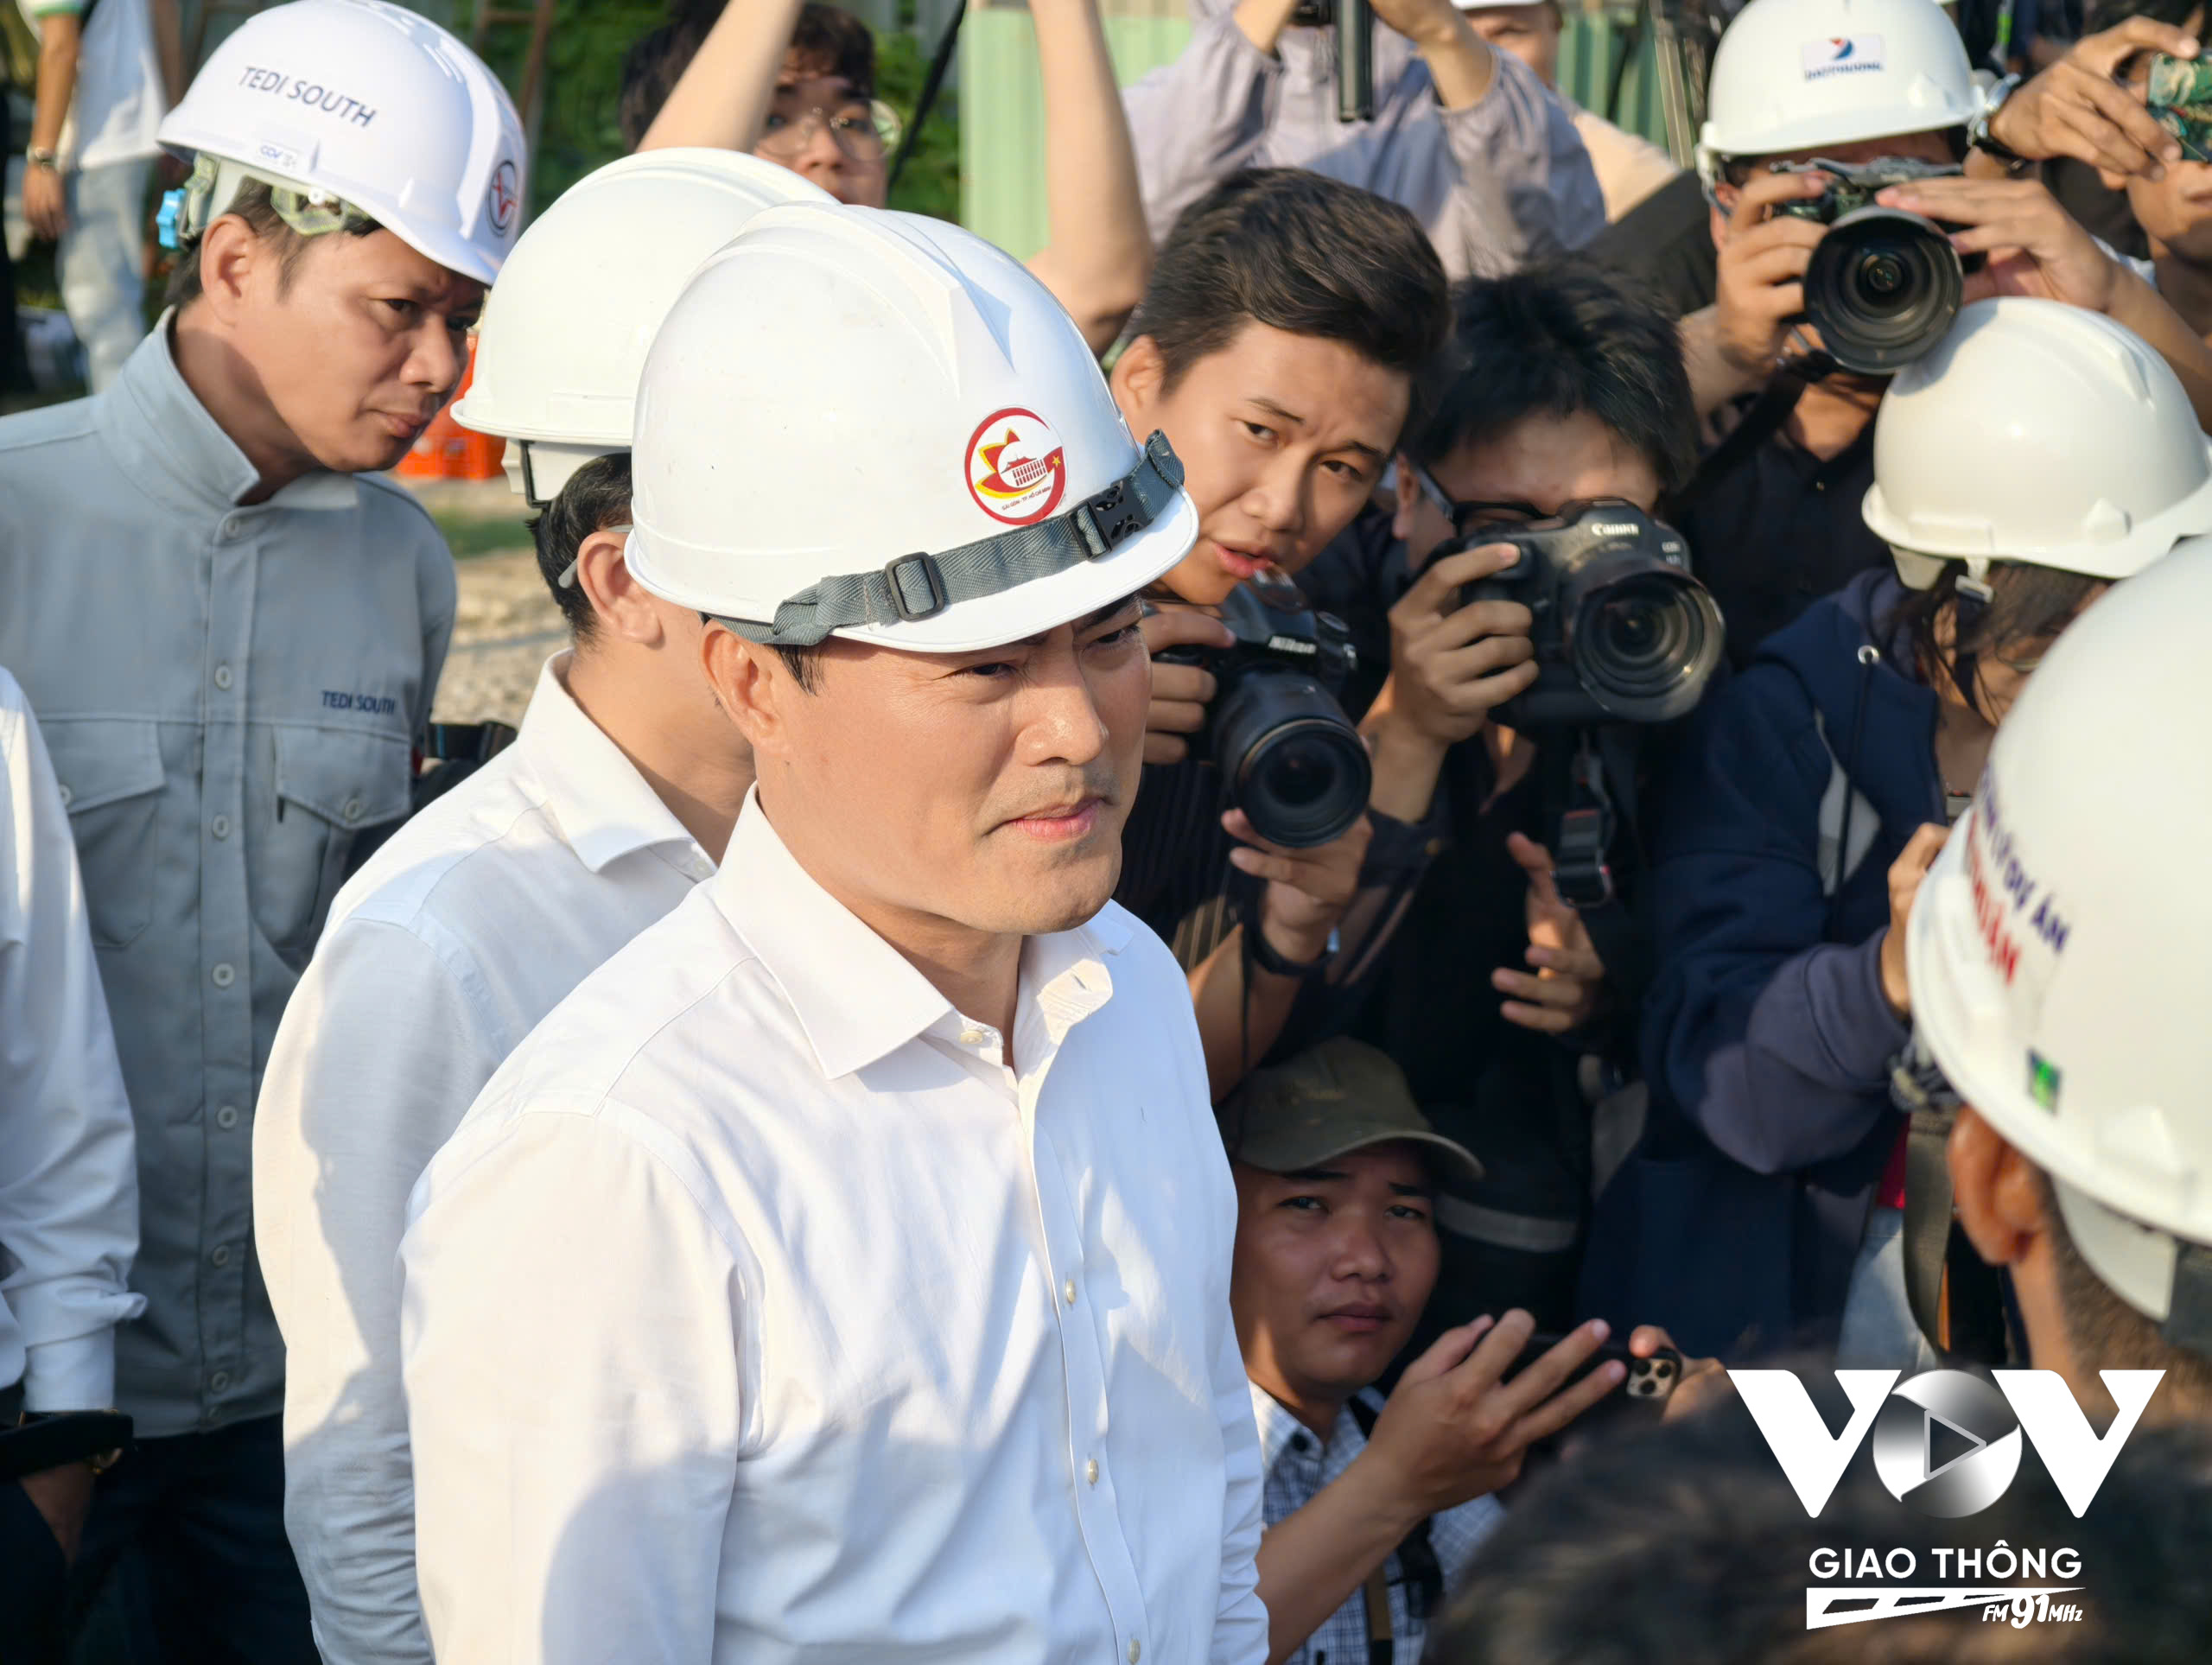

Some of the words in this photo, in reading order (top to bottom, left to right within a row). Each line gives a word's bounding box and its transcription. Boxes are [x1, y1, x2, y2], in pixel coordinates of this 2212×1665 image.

[238, 67, 289, 94] TEDI
[287, 80, 377, 128] SOUTH
[1591, 522, 1639, 536] Canon
[1268, 635, 1316, 654] Nikon
[322, 690, 353, 709] TEDI
[357, 694, 396, 715] SOUTH
